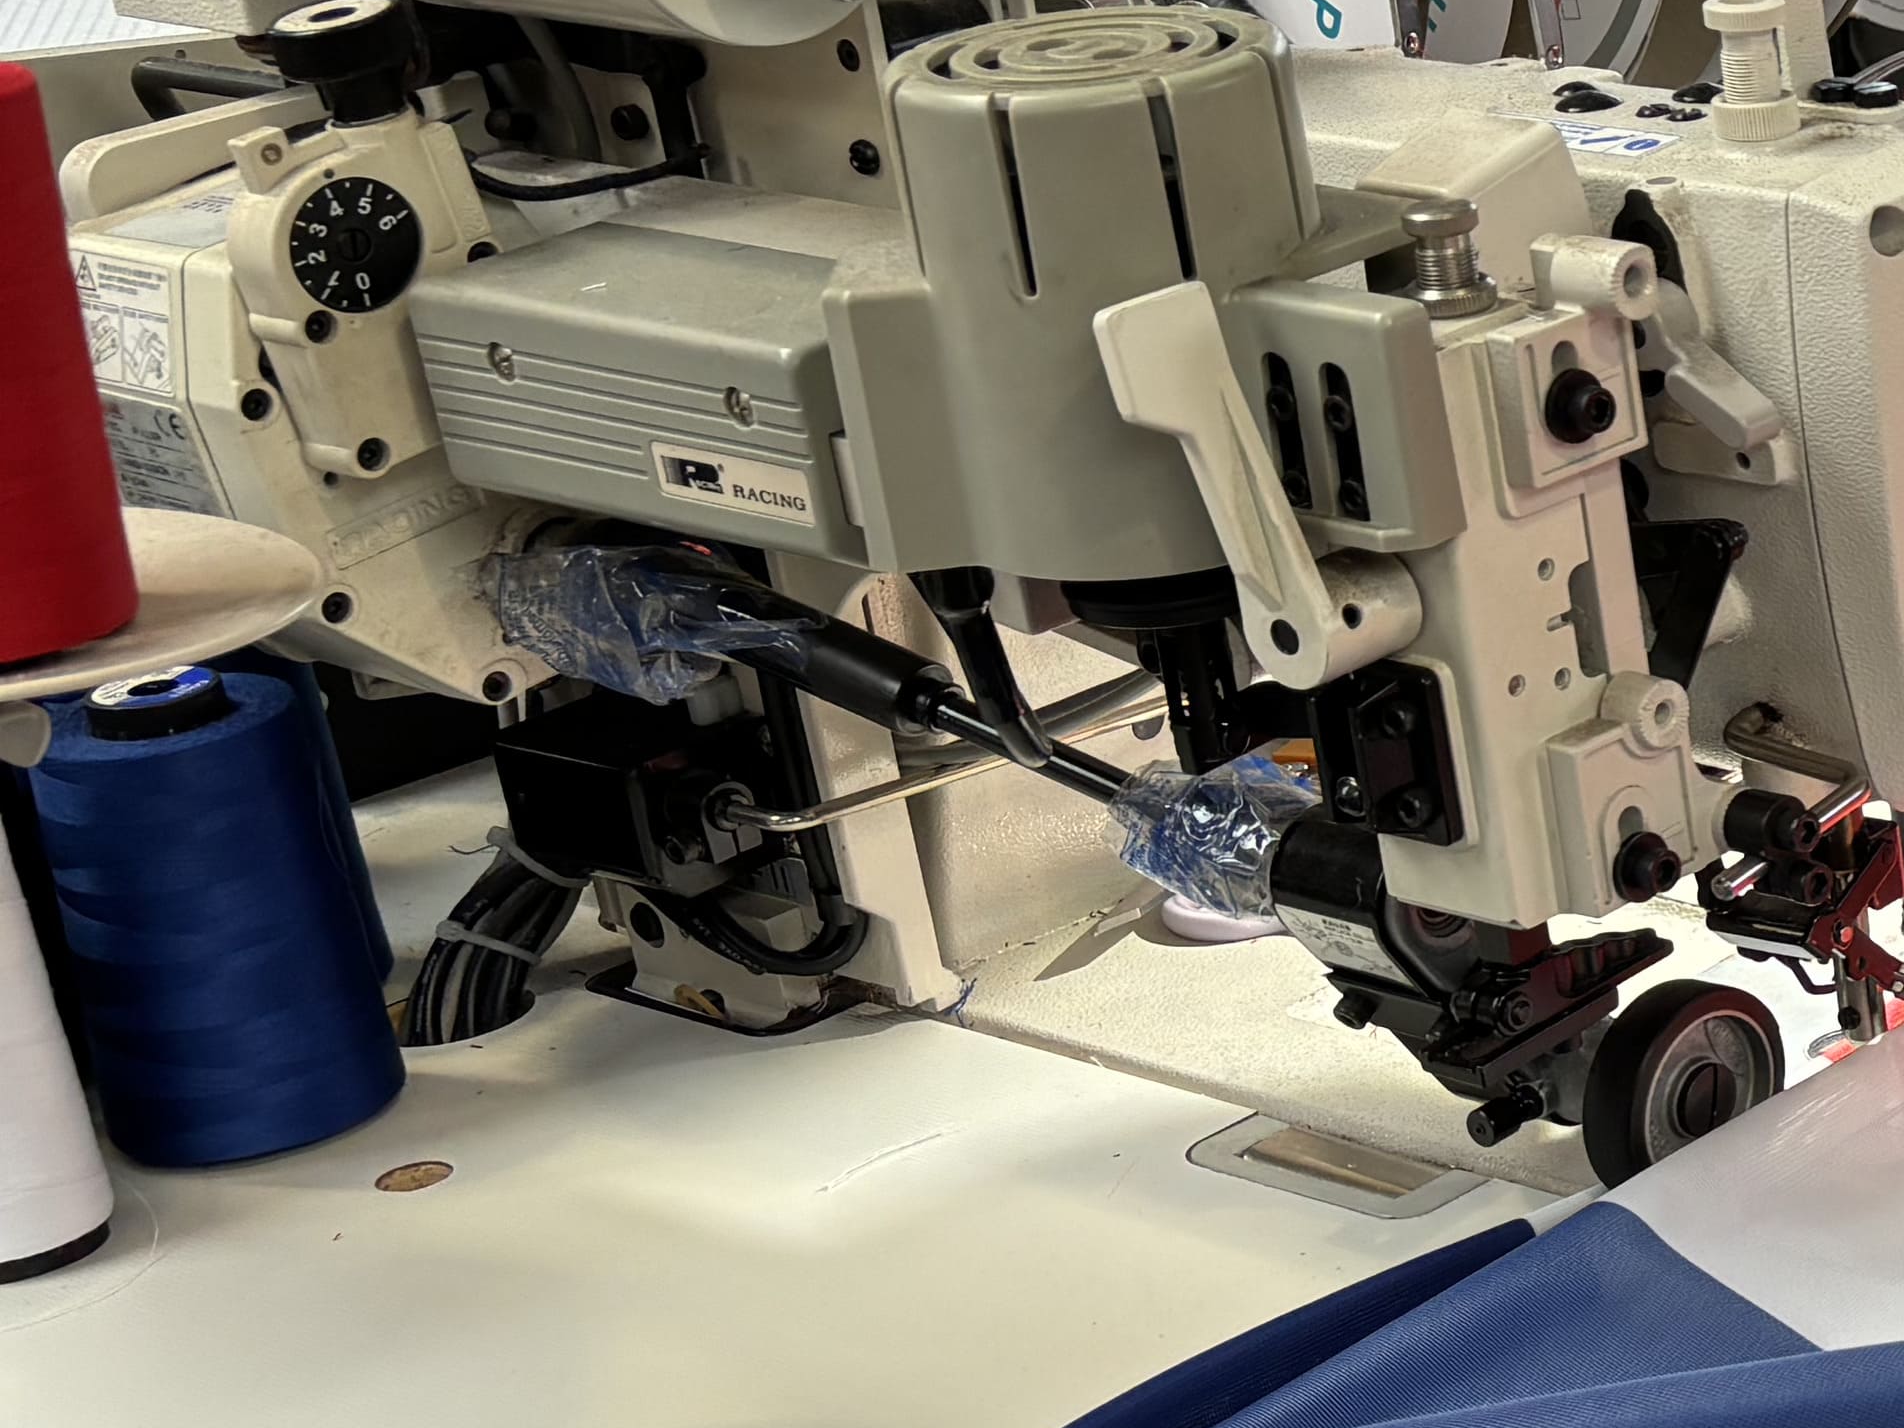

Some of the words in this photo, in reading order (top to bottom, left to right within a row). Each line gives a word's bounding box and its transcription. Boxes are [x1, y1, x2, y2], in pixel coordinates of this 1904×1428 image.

[329, 200, 344, 217] 4
[357, 197, 373, 215] 5
[308, 223, 328, 238] 3
[378, 215, 398, 231] 6
[308, 250, 328, 265] 2
[328, 270, 341, 286] 1
[355, 272, 371, 290] 0
[733, 484, 806, 511] RACING
